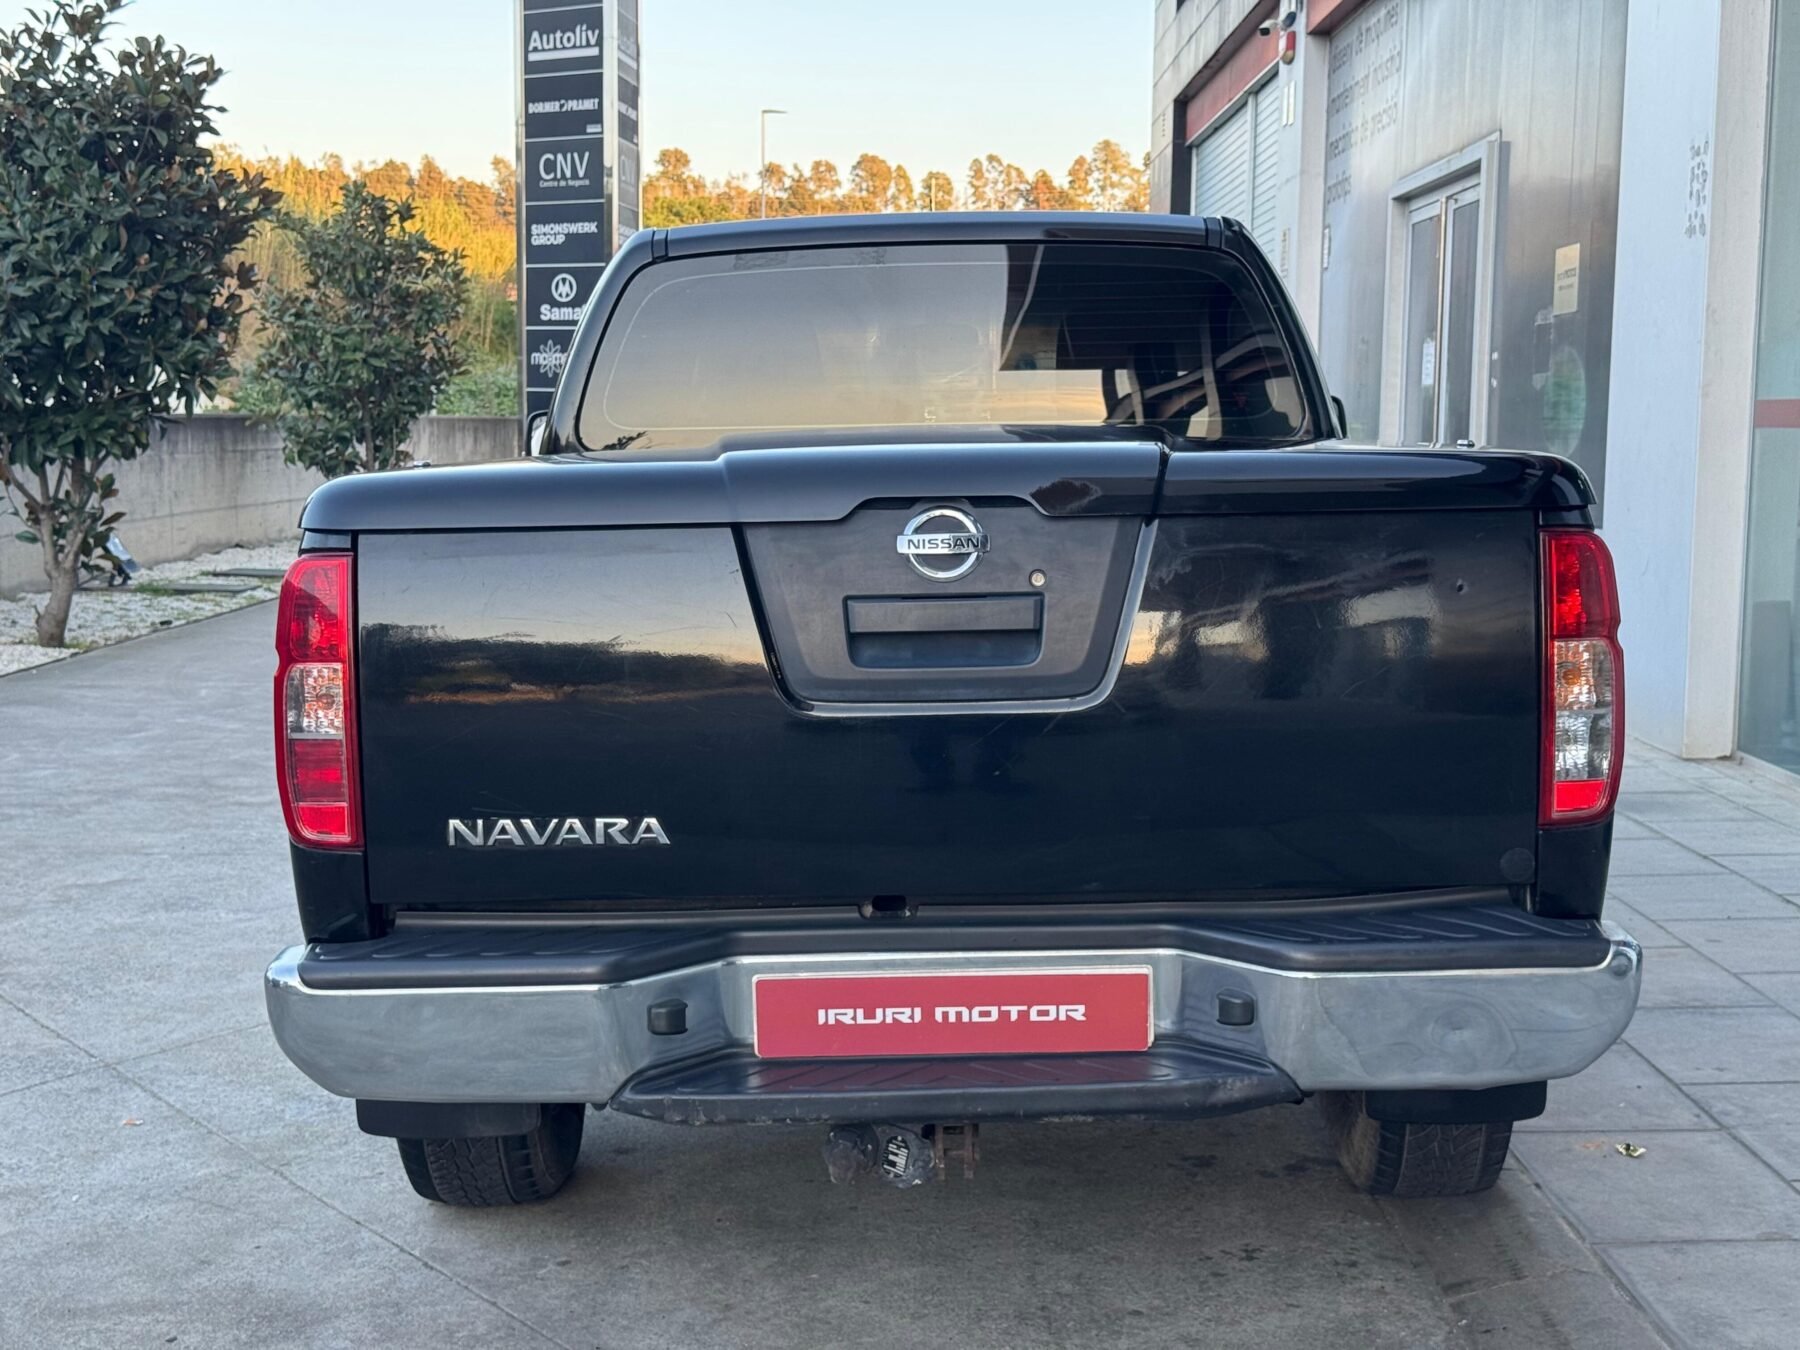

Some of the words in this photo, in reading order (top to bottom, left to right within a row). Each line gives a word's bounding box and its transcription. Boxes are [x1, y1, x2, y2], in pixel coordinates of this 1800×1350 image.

[528, 23, 600, 51] Autoliv
[539, 151, 590, 180] CNV
[531, 222, 598, 235] SIMONSWERK
[531, 234, 566, 246] GROUP
[540, 304, 587, 321] Sama
[907, 536, 980, 550] NISSAN
[448, 818, 671, 846] NAVARA
[818, 1007, 922, 1026] IRURI
[935, 1004, 1087, 1023] MOTOR
